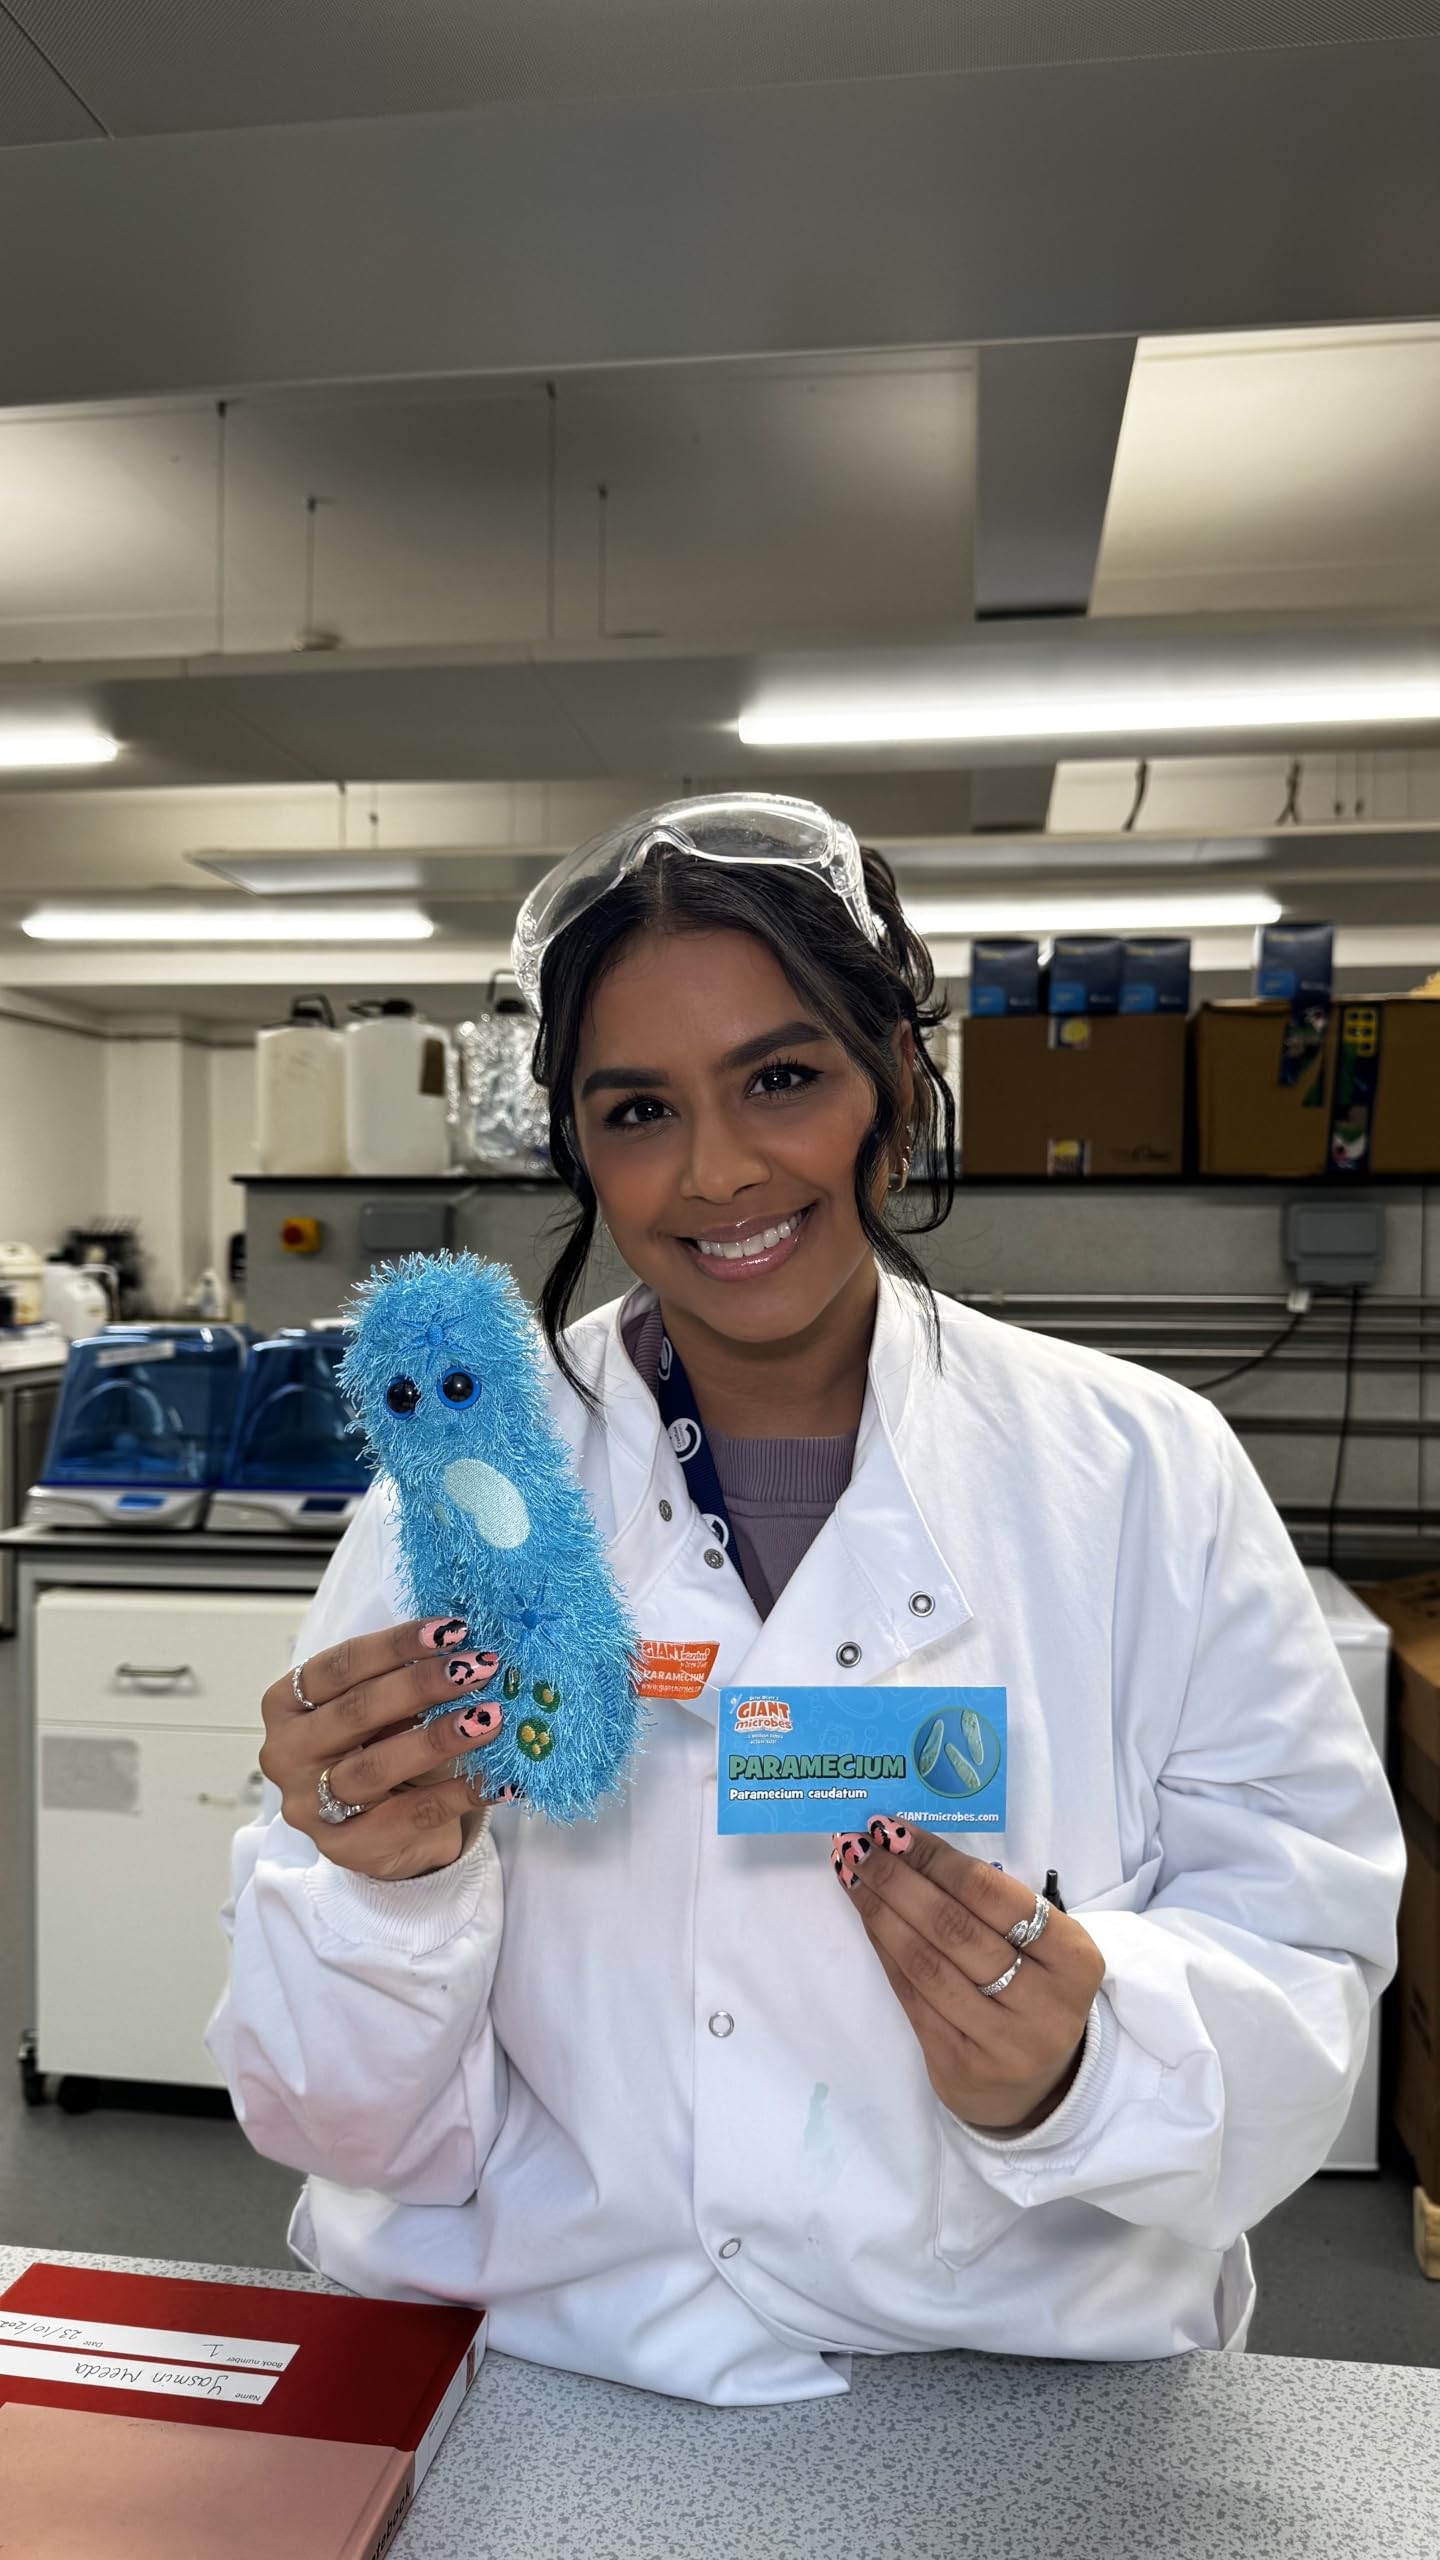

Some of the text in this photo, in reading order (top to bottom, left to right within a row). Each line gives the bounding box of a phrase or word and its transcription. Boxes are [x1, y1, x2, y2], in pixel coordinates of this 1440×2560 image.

[642, 1641, 685, 1660] GIANT
[737, 1701, 790, 1719] GIANT
[735, 1718, 792, 1730] microbes
[728, 1754, 906, 1780] PARAMECIUM
[729, 1787, 868, 1800] Paramecium caudatum
[896, 1811, 999, 1822] GIANTmicrobes.com
[83, 2340, 103, 2348] Date
[226, 2357, 283, 2368] Book number
[152, 2371, 228, 2395] Yasmin
[234, 2392, 261, 2402] Name
